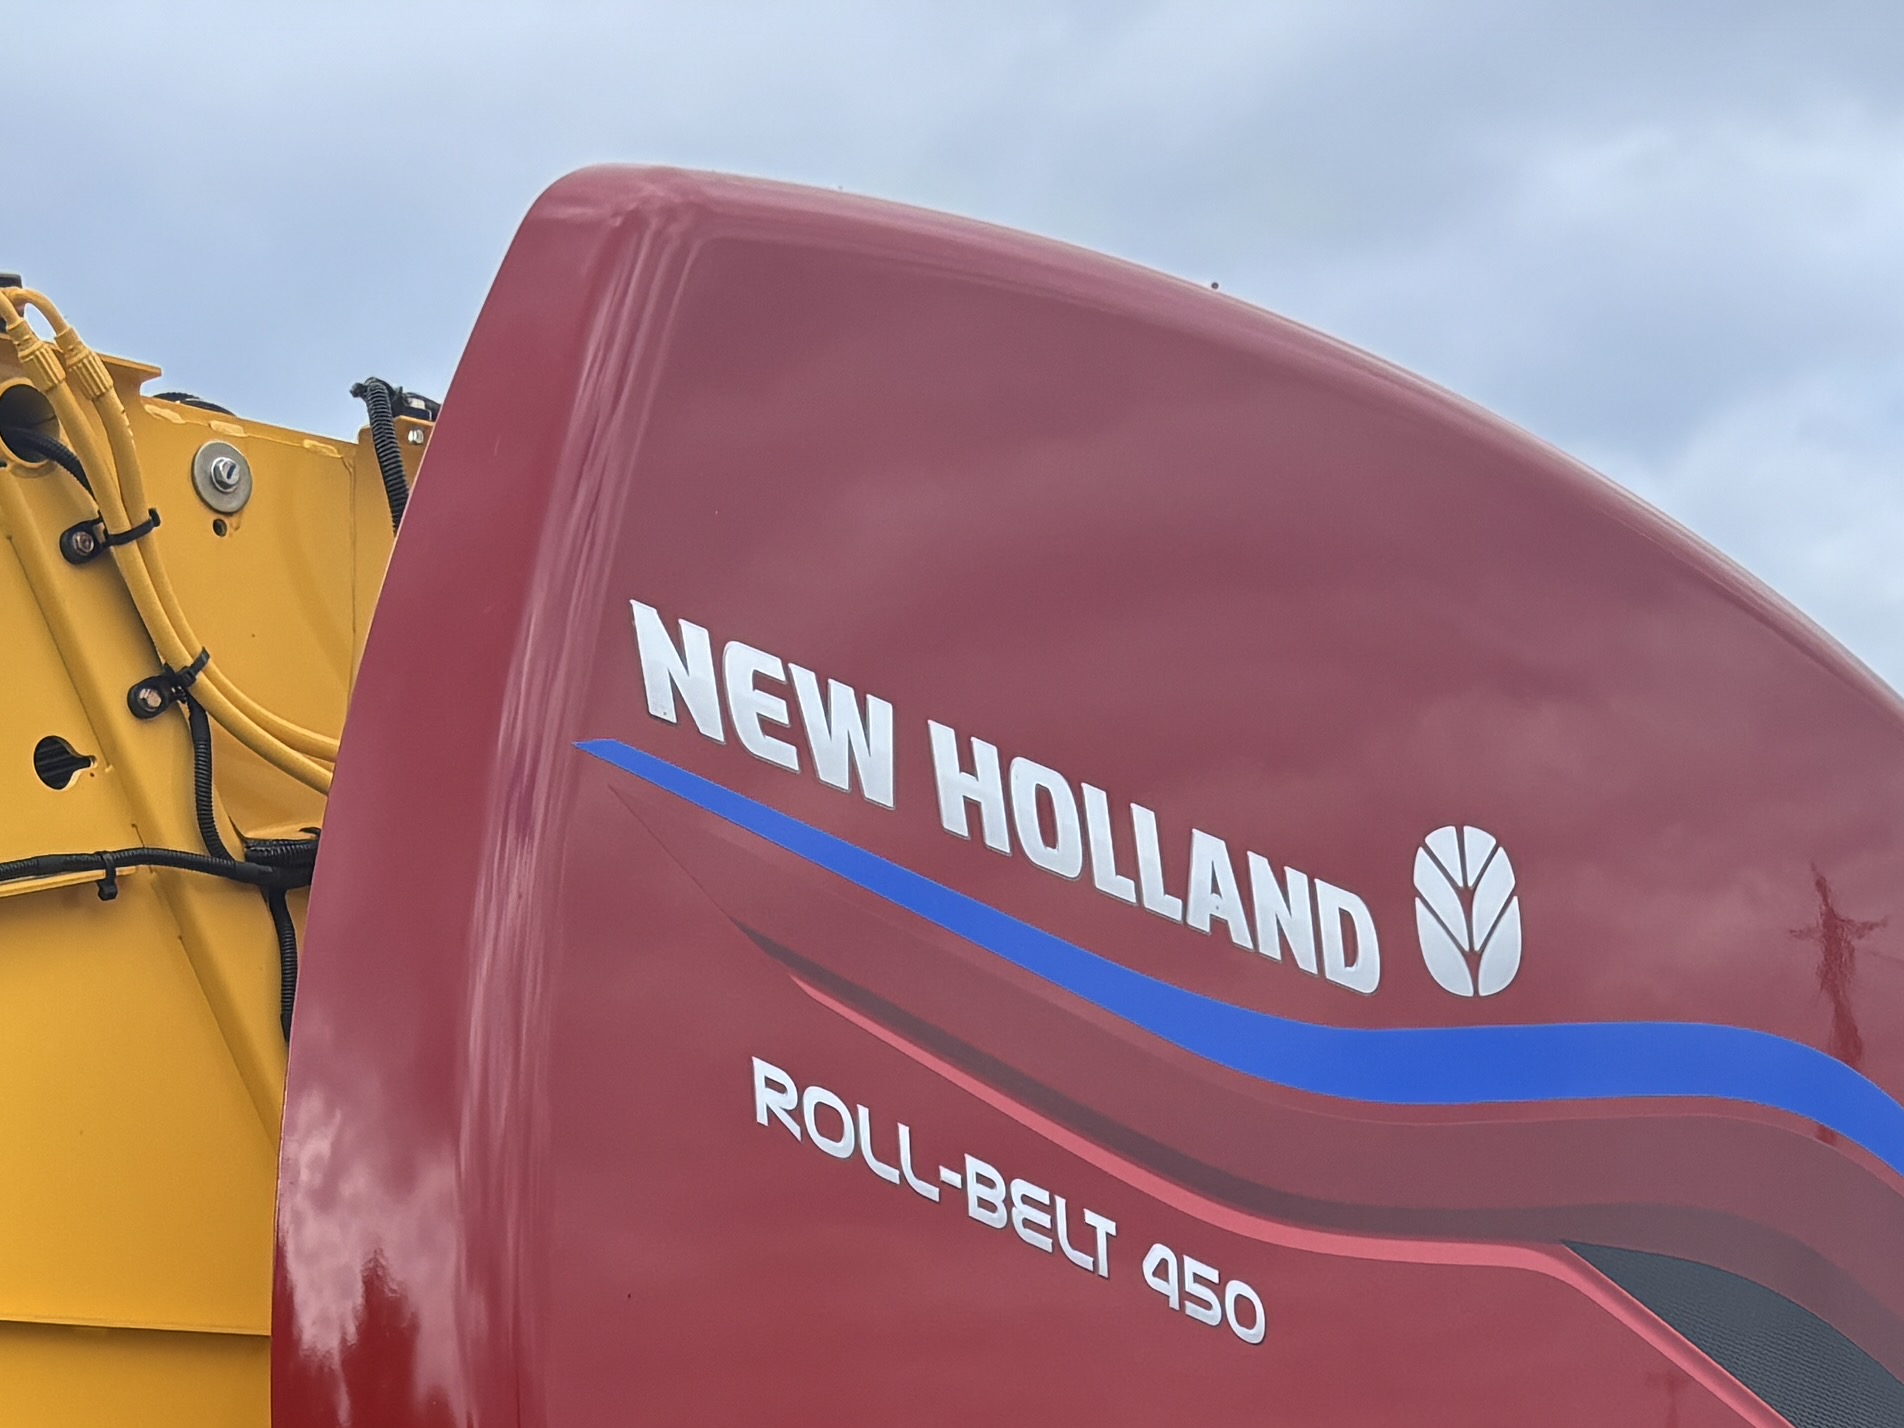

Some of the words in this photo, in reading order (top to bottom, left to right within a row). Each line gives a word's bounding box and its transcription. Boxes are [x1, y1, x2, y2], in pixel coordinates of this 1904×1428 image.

[629, 598, 895, 809] NEW
[927, 719, 1382, 995] HOLLAND
[751, 1055, 1118, 1279] ROLL-BELT
[1141, 1243, 1267, 1345] 450
